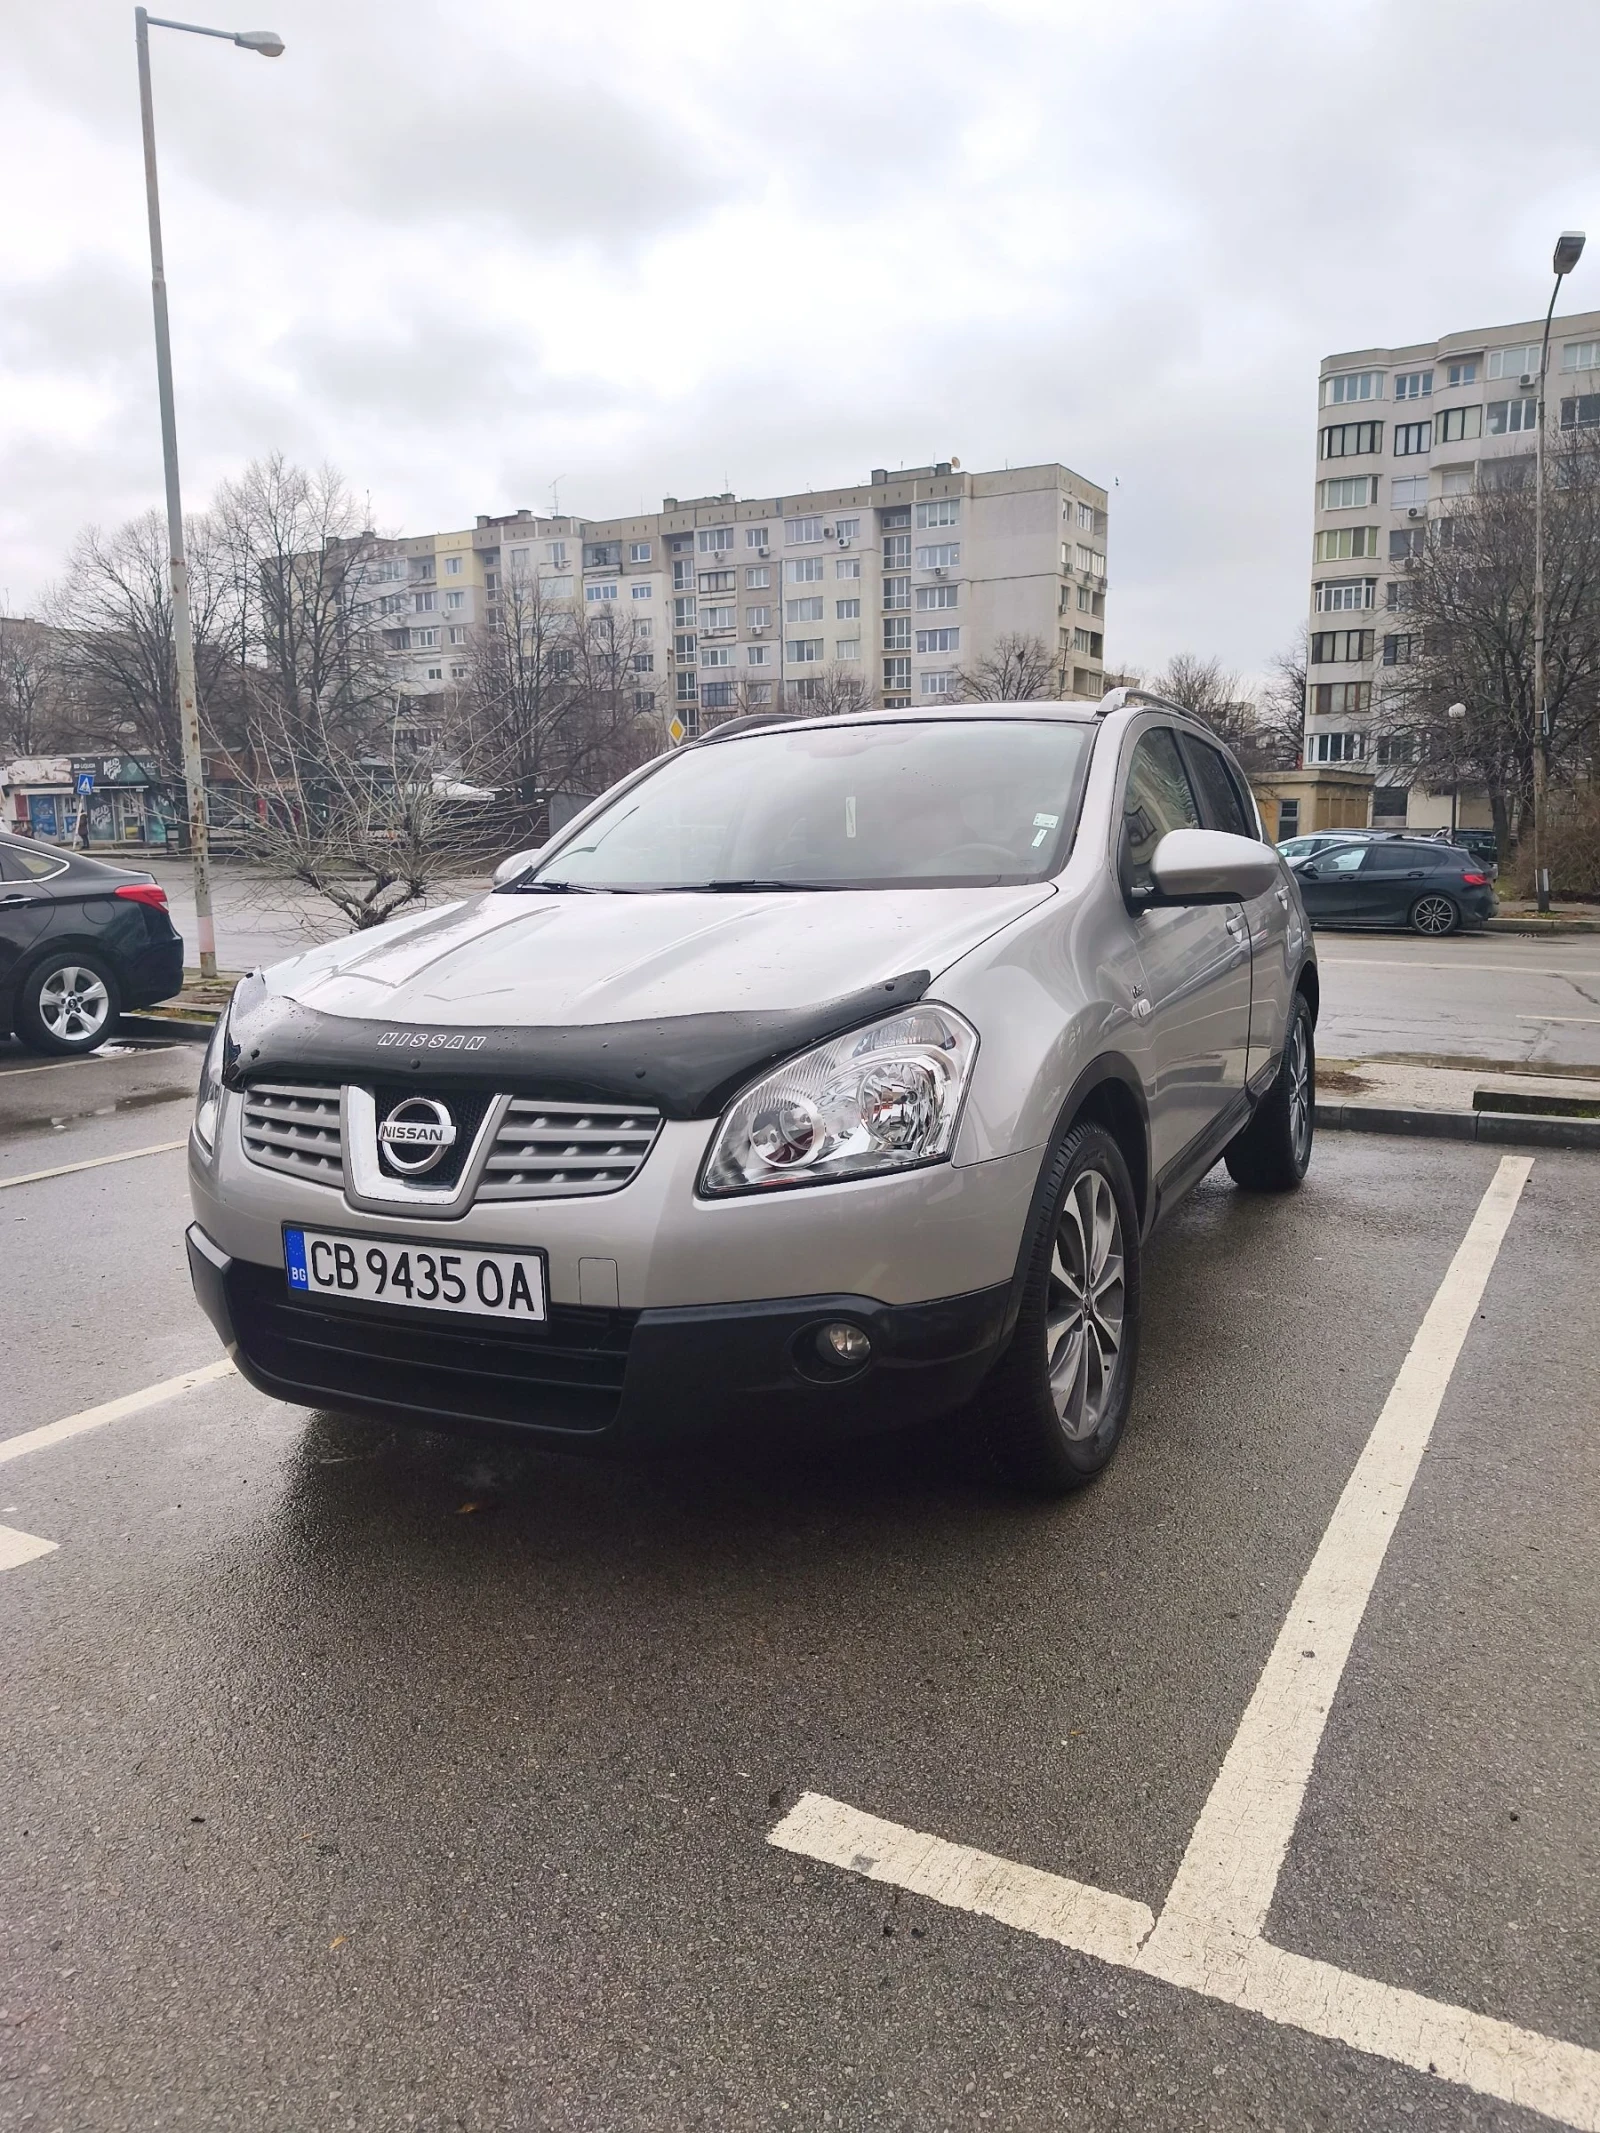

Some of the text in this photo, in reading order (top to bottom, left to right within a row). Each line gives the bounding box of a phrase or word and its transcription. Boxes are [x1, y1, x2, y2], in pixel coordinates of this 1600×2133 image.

[377, 1032, 487, 1050] NISSAN
[382, 1125, 443, 1141] NISSAN
[291, 1266, 306, 1282] BG
